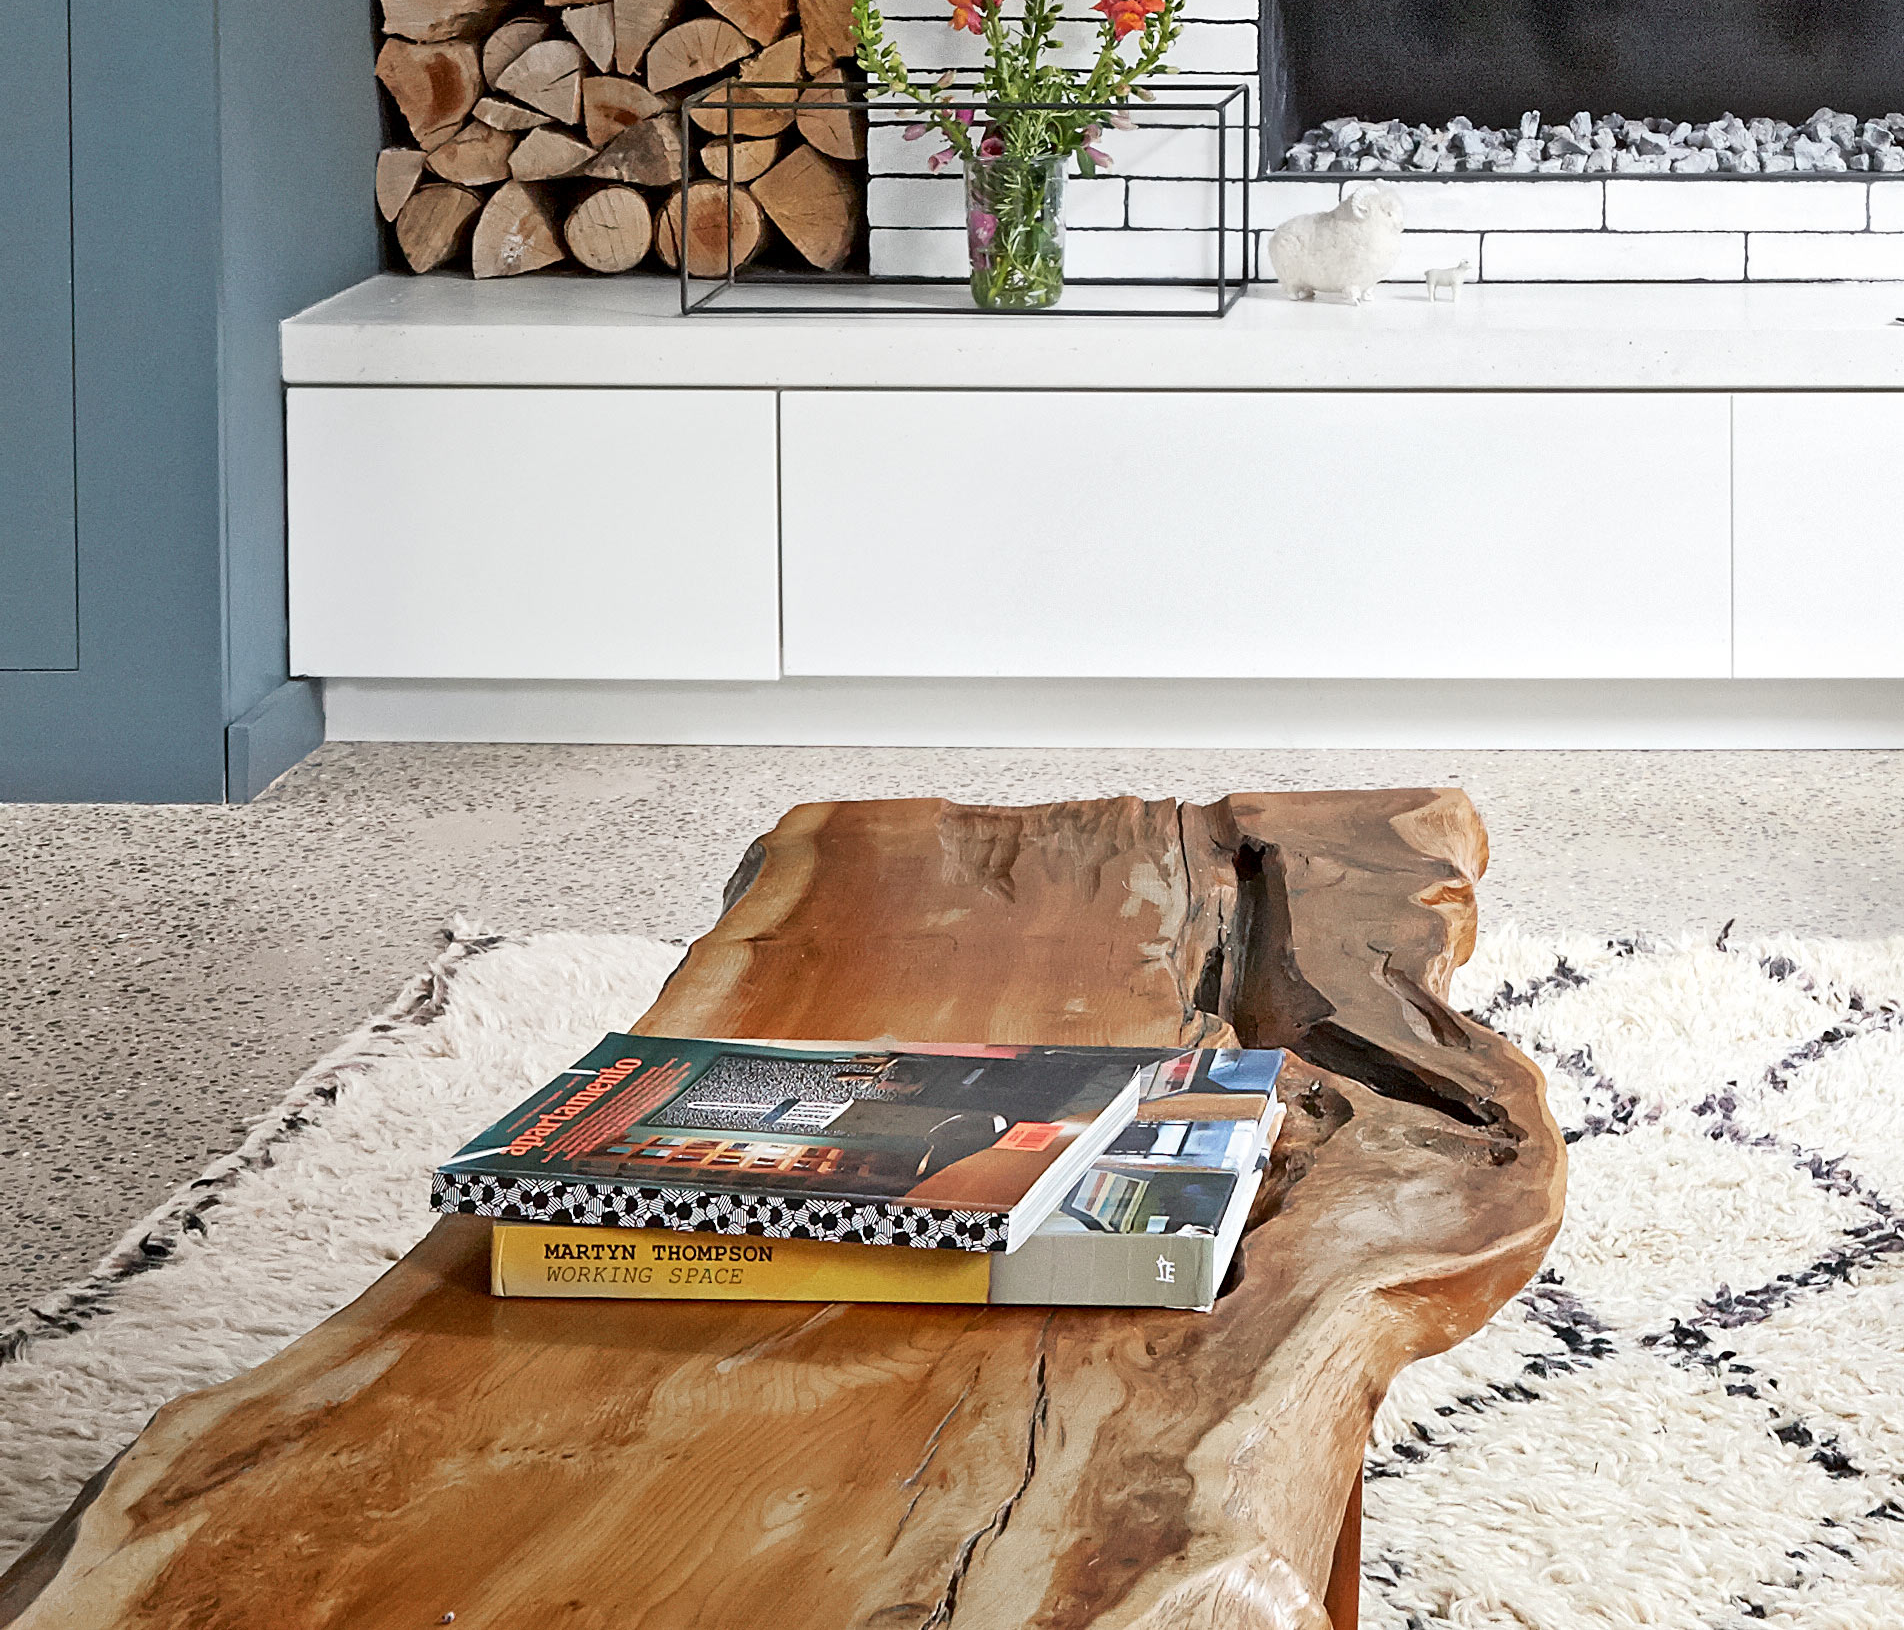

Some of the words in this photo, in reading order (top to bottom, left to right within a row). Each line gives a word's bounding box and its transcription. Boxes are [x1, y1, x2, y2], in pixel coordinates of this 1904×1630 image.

[507, 1057, 643, 1156] apartamento
[543, 1243, 637, 1261] MARTYN
[652, 1244, 774, 1263] THOMPSON
[546, 1266, 653, 1284] WORKING
[668, 1267, 744, 1285] SPACE
